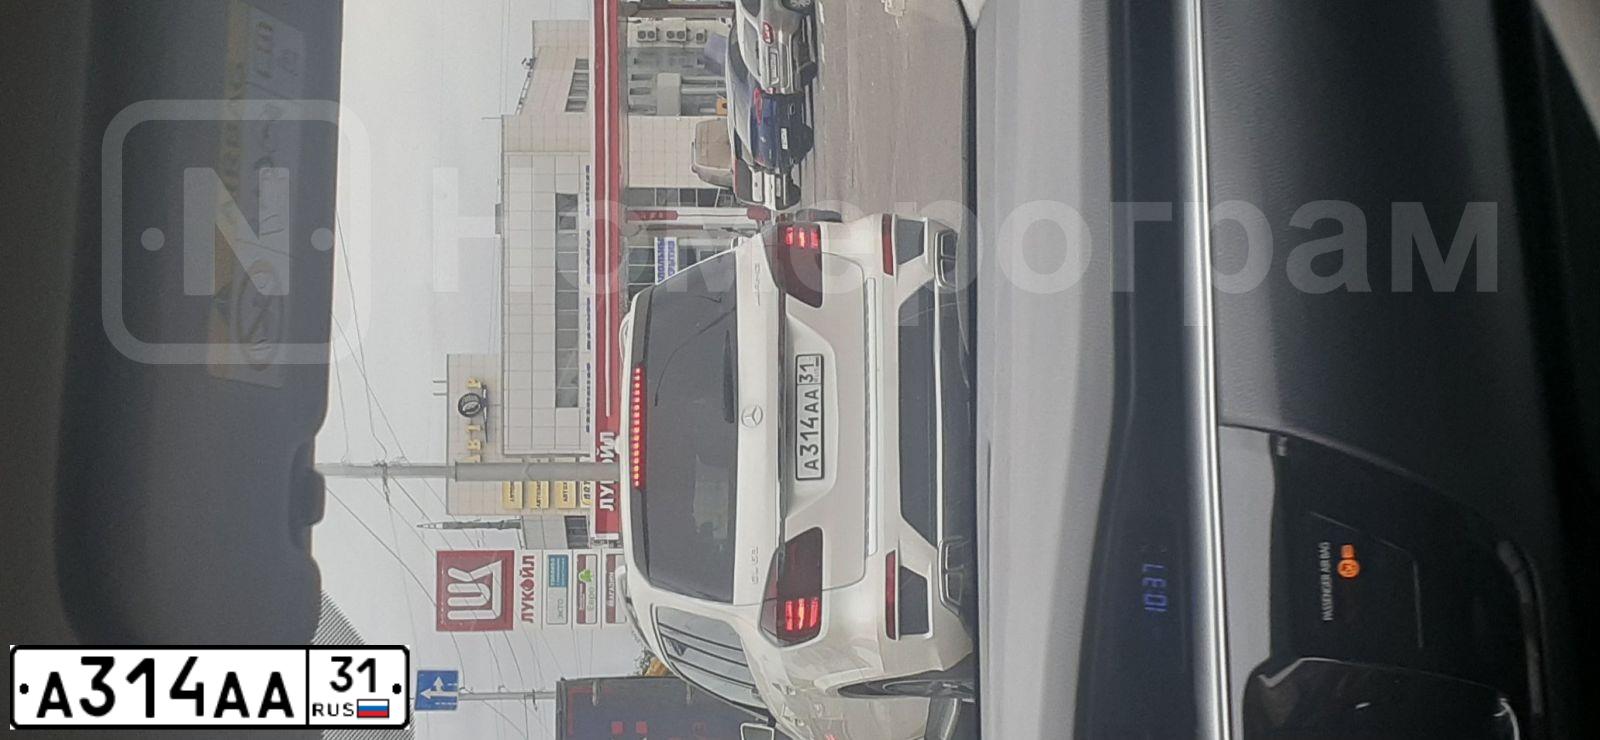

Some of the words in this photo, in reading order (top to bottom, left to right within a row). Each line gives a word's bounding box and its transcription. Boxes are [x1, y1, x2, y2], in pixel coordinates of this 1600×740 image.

[799, 363, 814, 383] 31
[799, 389, 819, 471] А314АА
[597, 431, 615, 511] ЛУЙЛ
[519, 555, 535, 623] ЛУКОЙЛ
[1321, 574, 1334, 621] PASSENGER
